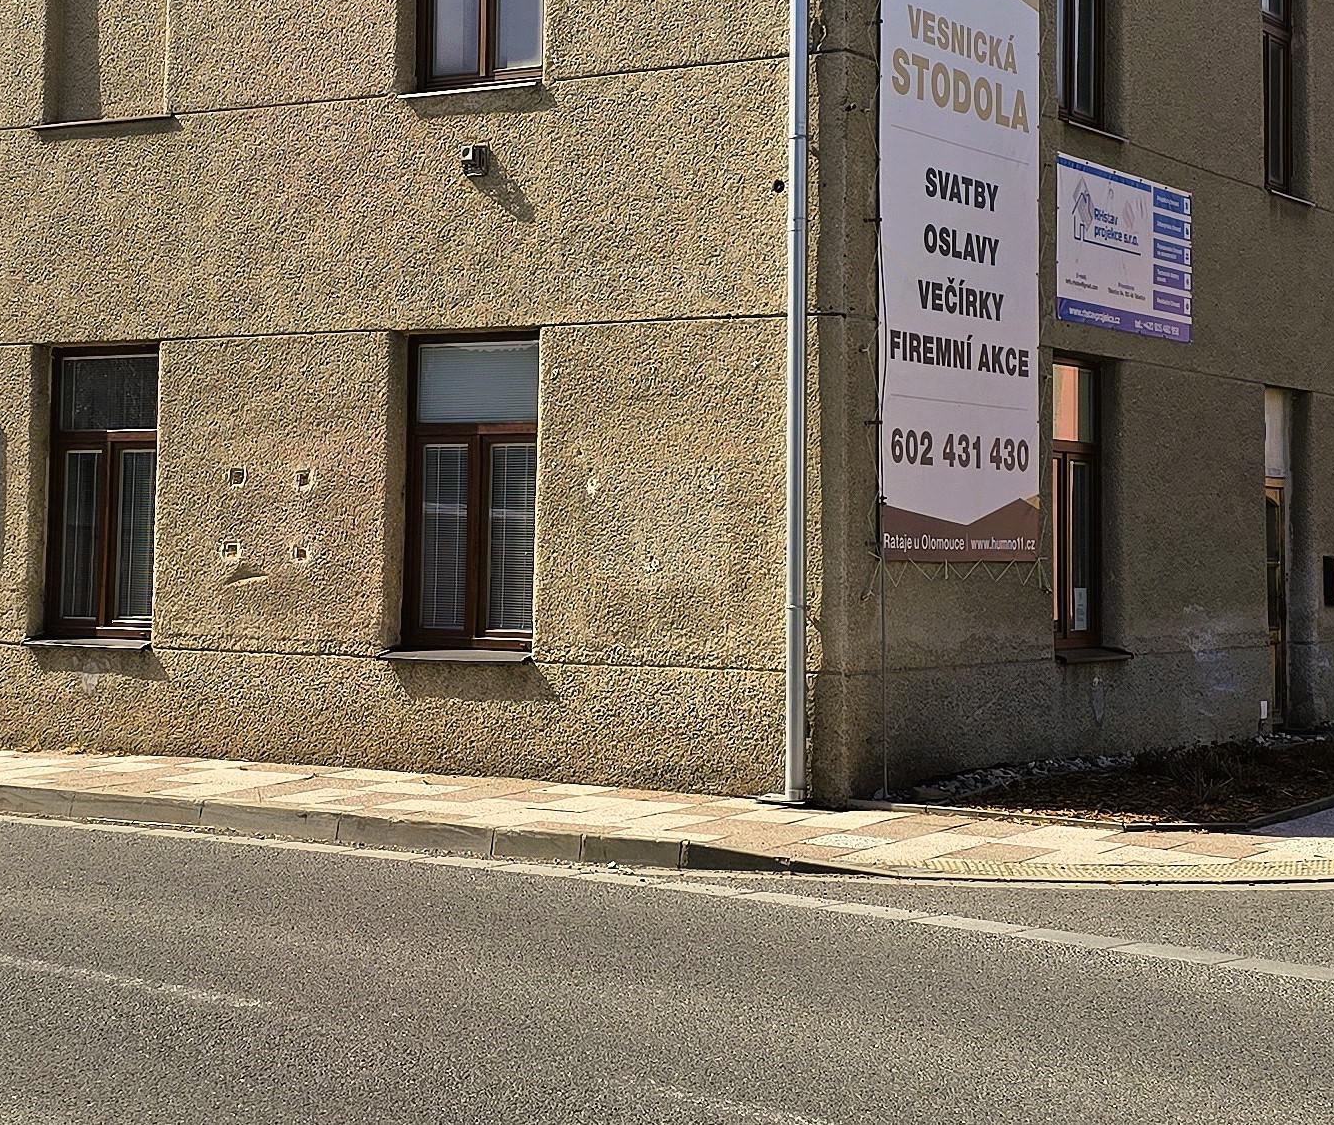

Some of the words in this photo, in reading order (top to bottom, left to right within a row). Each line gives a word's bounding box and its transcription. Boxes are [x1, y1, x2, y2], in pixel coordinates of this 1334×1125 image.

[907, 4, 1018, 75] VESNICKÁ
[891, 47, 1030, 134] STODOLA
[925, 167, 999, 212] SVATBY
[924, 224, 1000, 266] OSLAVY
[917, 277, 1005, 322] VEČÍRKY
[890, 329, 973, 371] FIREMNÍ
[977, 343, 1030, 378] AKCE
[891, 427, 934, 466] 602
[942, 433, 981, 469] 431
[989, 437, 1030, 473] 430
[883, 532, 912, 553] Rataje
[913, 538, 920, 547] u
[921, 534, 965, 551] Olomouce
[970, 535, 1036, 551] www.humno11.cz
